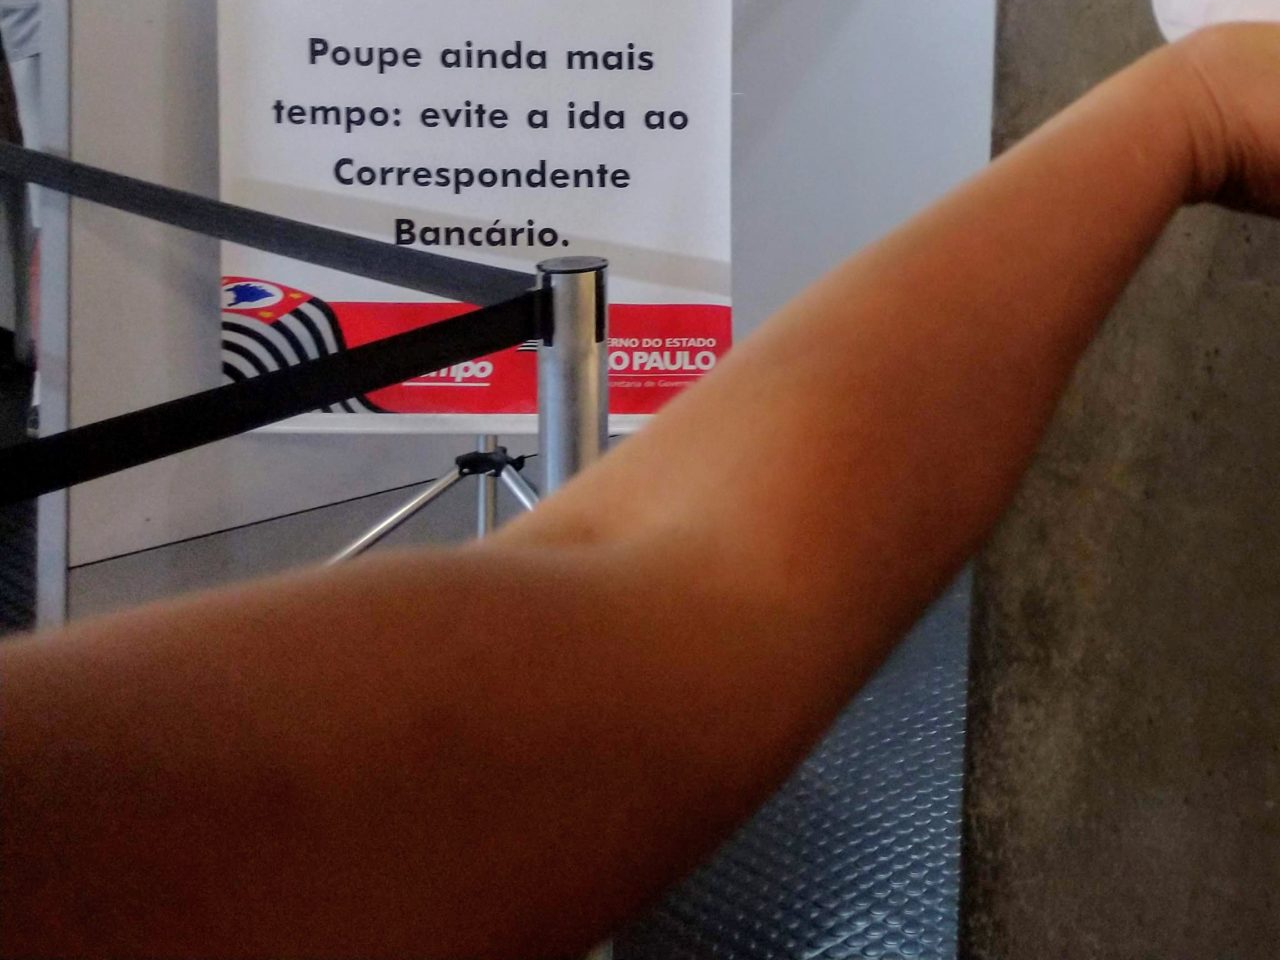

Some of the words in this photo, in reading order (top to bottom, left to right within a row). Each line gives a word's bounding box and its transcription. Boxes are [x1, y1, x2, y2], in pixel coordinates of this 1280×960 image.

[307, 37, 423, 75] Poupe
[439, 40, 548, 71] ainda
[565, 41, 655, 72] mais
[271, 98, 402, 134] tempo:
[419, 98, 510, 130] evite
[526, 108, 549, 130] a
[567, 100, 626, 131] ida
[643, 109, 690, 131] ao
[333, 156, 632, 195] Correspondente
[393, 217, 571, 249] Bancário.
[607, 337, 639, 348] ERNO
[641, 337, 663, 348] DO
[665, 338, 717, 348] ESTADO
[632, 351, 717, 371] PAULO
